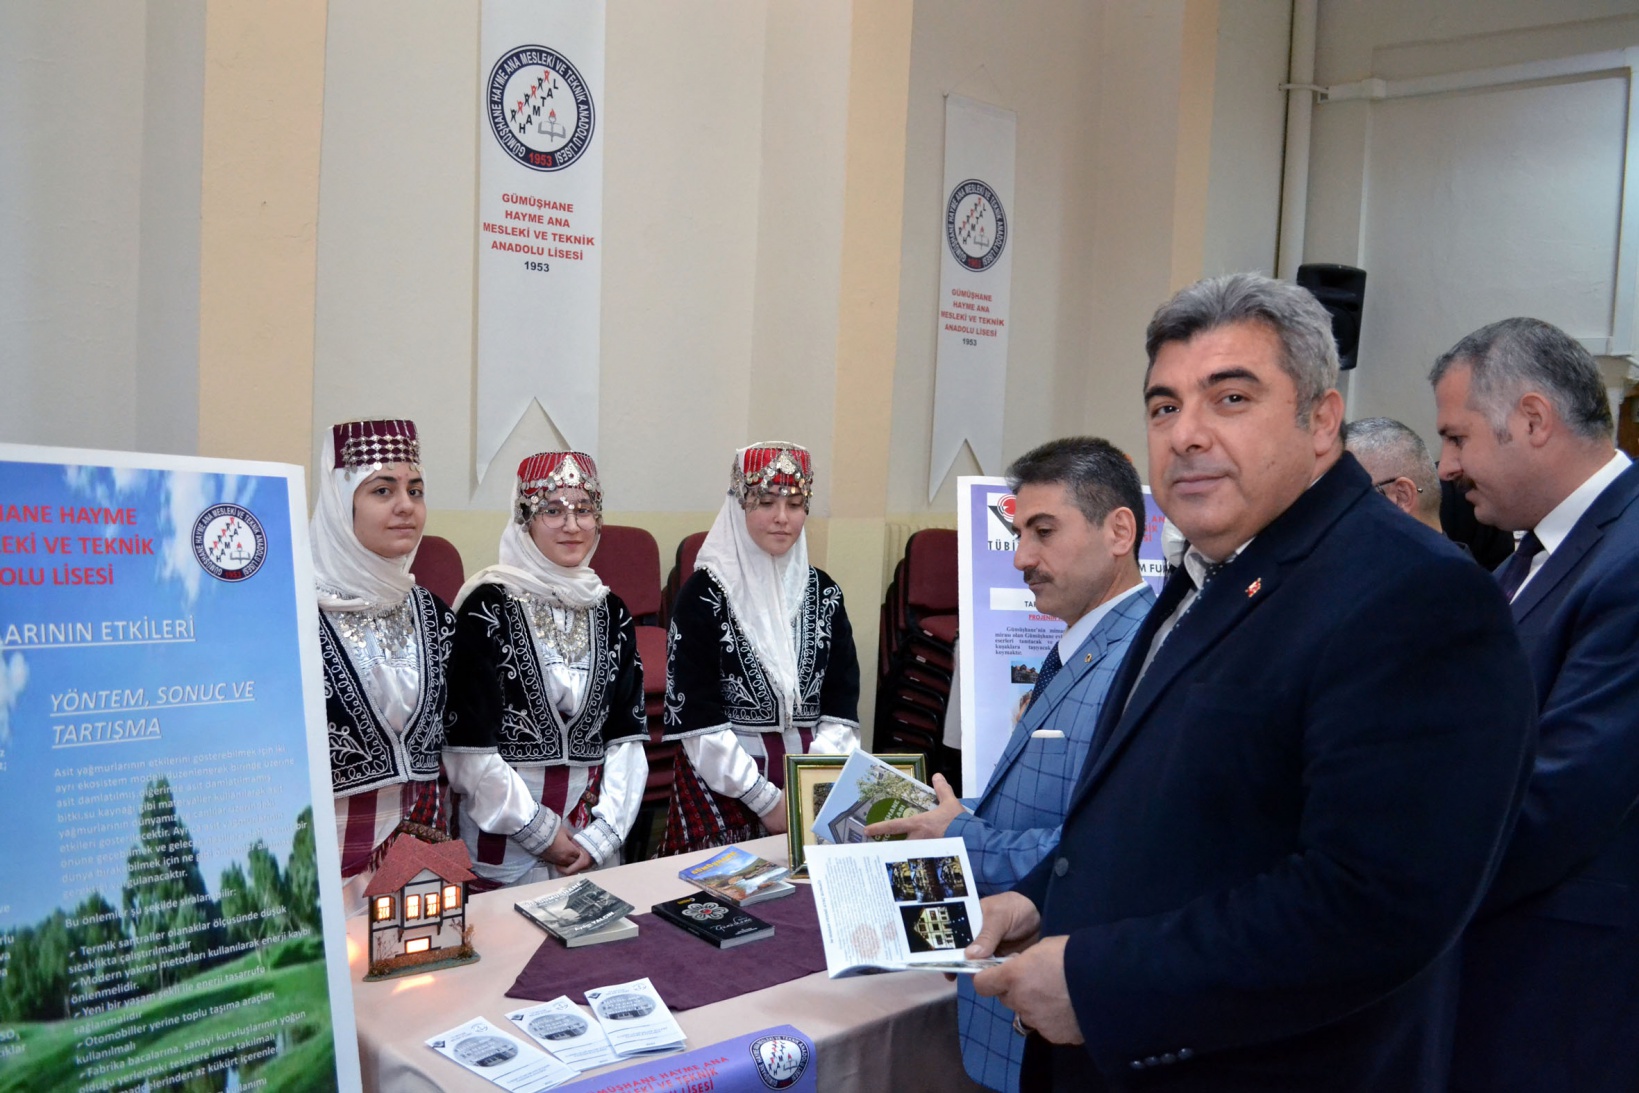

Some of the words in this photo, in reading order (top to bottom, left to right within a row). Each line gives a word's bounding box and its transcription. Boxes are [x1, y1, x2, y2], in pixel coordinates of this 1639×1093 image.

[504, 57, 521, 74] ANA
[520, 52, 556, 66] MESLEKİ
[556, 60, 567, 75] VE
[492, 69, 508, 101] HAYME
[565, 70, 586, 103] TEKNİK
[492, 104, 526, 157] GÜMÜŞHANE
[572, 104, 590, 147] ANADOLU
[528, 152, 553, 167] 1953
[555, 143, 577, 166] LİSESİ
[502, 193, 574, 212] GÜMÜŞHANE
[505, 210, 544, 224] HAYME
[547, 216, 570, 228] ANA
[483, 222, 530, 238] MESLEKİ
[534, 230, 548, 240] VE
[552, 232, 595, 246] TEKNİK
[491, 240, 544, 256] ANADOLU
[548, 247, 583, 260] LİSESİ
[524, 261, 550, 272] 1953
[952, 288, 992, 302] GÜMÜŞHANE
[953, 300, 975, 310] HAYME
[941, 310, 967, 321] MESLEKİ
[978, 316, 1004, 326] TEKNİK
[945, 324, 974, 334] ANADOLU
[976, 328, 997, 336] LİSESİ
[962, 338, 977, 346] 1953
[60, 506, 137, 526] HAYME
[43, 537, 72, 554] VE
[78, 534, 154, 556] TEKNİK
[52, 563, 114, 586] LİSESİ
[102, 615, 196, 642] ETKİLERİ
[50, 688, 150, 712] YÖNTEM,
[156, 681, 227, 705] SONUÇ
[233, 680, 255, 698] VE
[53, 717, 162, 745] TARTIŞMA
[53, 767, 74, 777] Asit
[76, 759, 145, 777] yağmurlarının
[148, 754, 190, 767] etkilerini
[54, 783, 74, 794] ayrı
[77, 776, 127, 790] ekosistem
[55, 797, 76, 807] asit
[58, 819, 129, 840] yağmurlarının
[295, 820, 307, 830] bir
[155, 844, 166, 852] ve
[162, 855, 180, 867] için
[181, 854, 194, 862] ne
[65, 917, 78, 928] Bu
[81, 907, 127, 925] önlemler
[130, 906, 142, 917] şu
[79, 939, 116, 956] Termik
[118, 929, 165, 948] santraller
[166, 920, 210, 938] olanaklar
[212, 910, 259, 929] ölçüsünde
[260, 904, 287, 919] düşük
[67, 954, 117, 974] sıcaklıkta
[80, 969, 122, 986] Modern
[124, 961, 157, 978] yakma
[160, 949, 205, 968] metodları
[207, 937, 259, 957] kullanılarak
[261, 932, 286, 946] enerji
[70, 979, 139, 1004] önlenmelidir.
[82, 1002, 104, 1016] Yeni
[107, 998, 121, 1010] bir
[123, 992, 155, 1009] yaşam
[195, 974, 222, 989] enerji
[73, 1009, 143, 1036] sağlanmalıdır
[85, 1022, 147, 1047] Otomobiller
[149, 1013, 180, 1032] yerine
[182, 1006, 207, 1023] toplu
[209, 998, 240, 1017] taşıma
[241, 988, 275, 1008] araçları
[75, 1040, 136, 1065] kullanılmalı
[87, 1058, 125, 1077] Fabrika
[183, 1034, 214, 1052] sanayi
[216, 1016, 278, 1043] kuruluşlarının
[279, 1009, 306, 1026] yoğun
[78, 1076, 115, 1093] olduğu
[116, 1061, 167, 1085] yerlerdeki
[169, 1049, 210, 1069] tesislere
[211, 1042, 233, 1057] filtre
[236, 1030, 275, 1050] takılmalı
[195, 1067, 205, 1077] az
[207, 1055, 238, 1072] kükürt
[659, 1064, 699, 1079] HAYME
[704, 1056, 729, 1068] ANA
[657, 1079, 675, 1090] VE
[676, 1066, 719, 1086] TEKNİK
